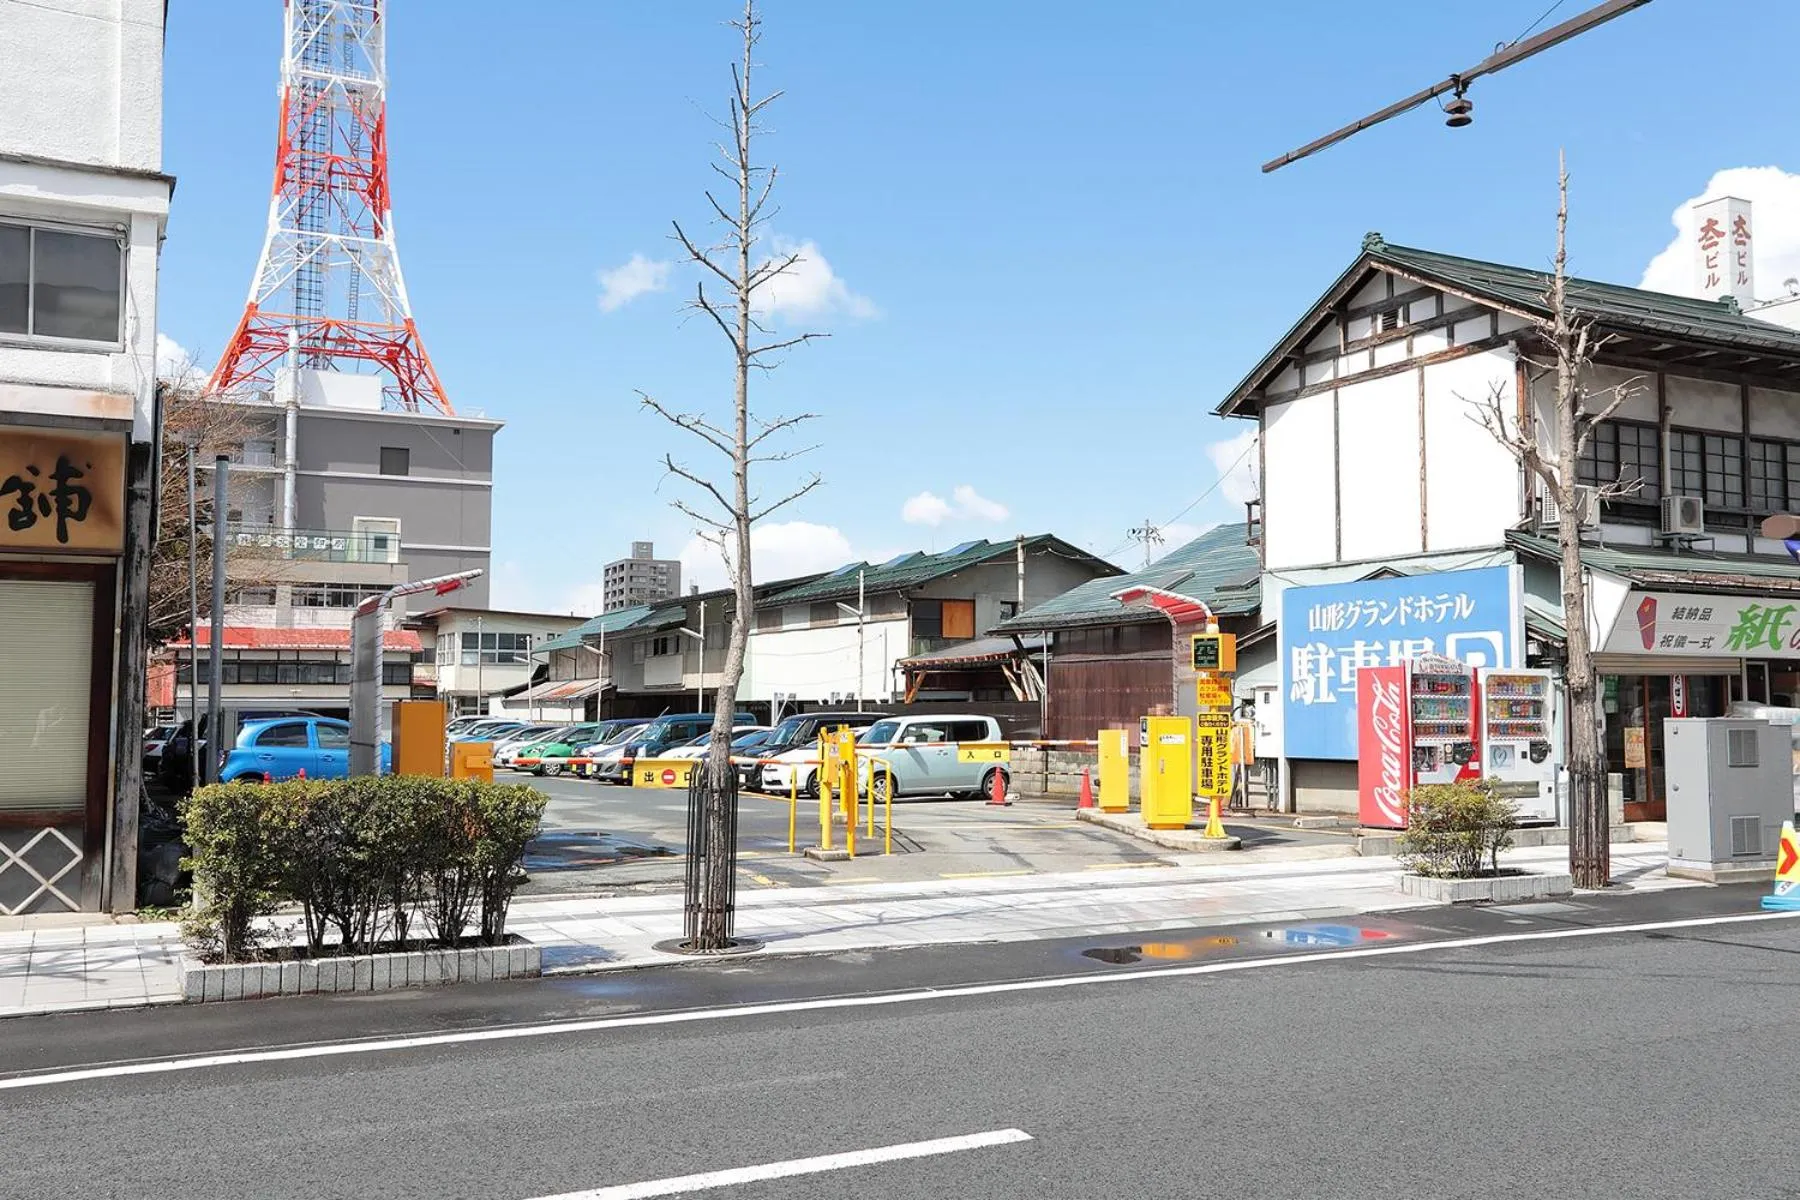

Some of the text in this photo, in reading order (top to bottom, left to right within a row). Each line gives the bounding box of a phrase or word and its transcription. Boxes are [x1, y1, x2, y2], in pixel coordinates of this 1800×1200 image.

[1308, 593, 1475, 632] 山形グランドホテル
[1671, 606, 1713, 621] 結納品
[1722, 603, 1800, 652] 紙
[1659, 634, 1715, 649] 祝儀一式
[1201, 735, 1213, 789] 専用駐車場
